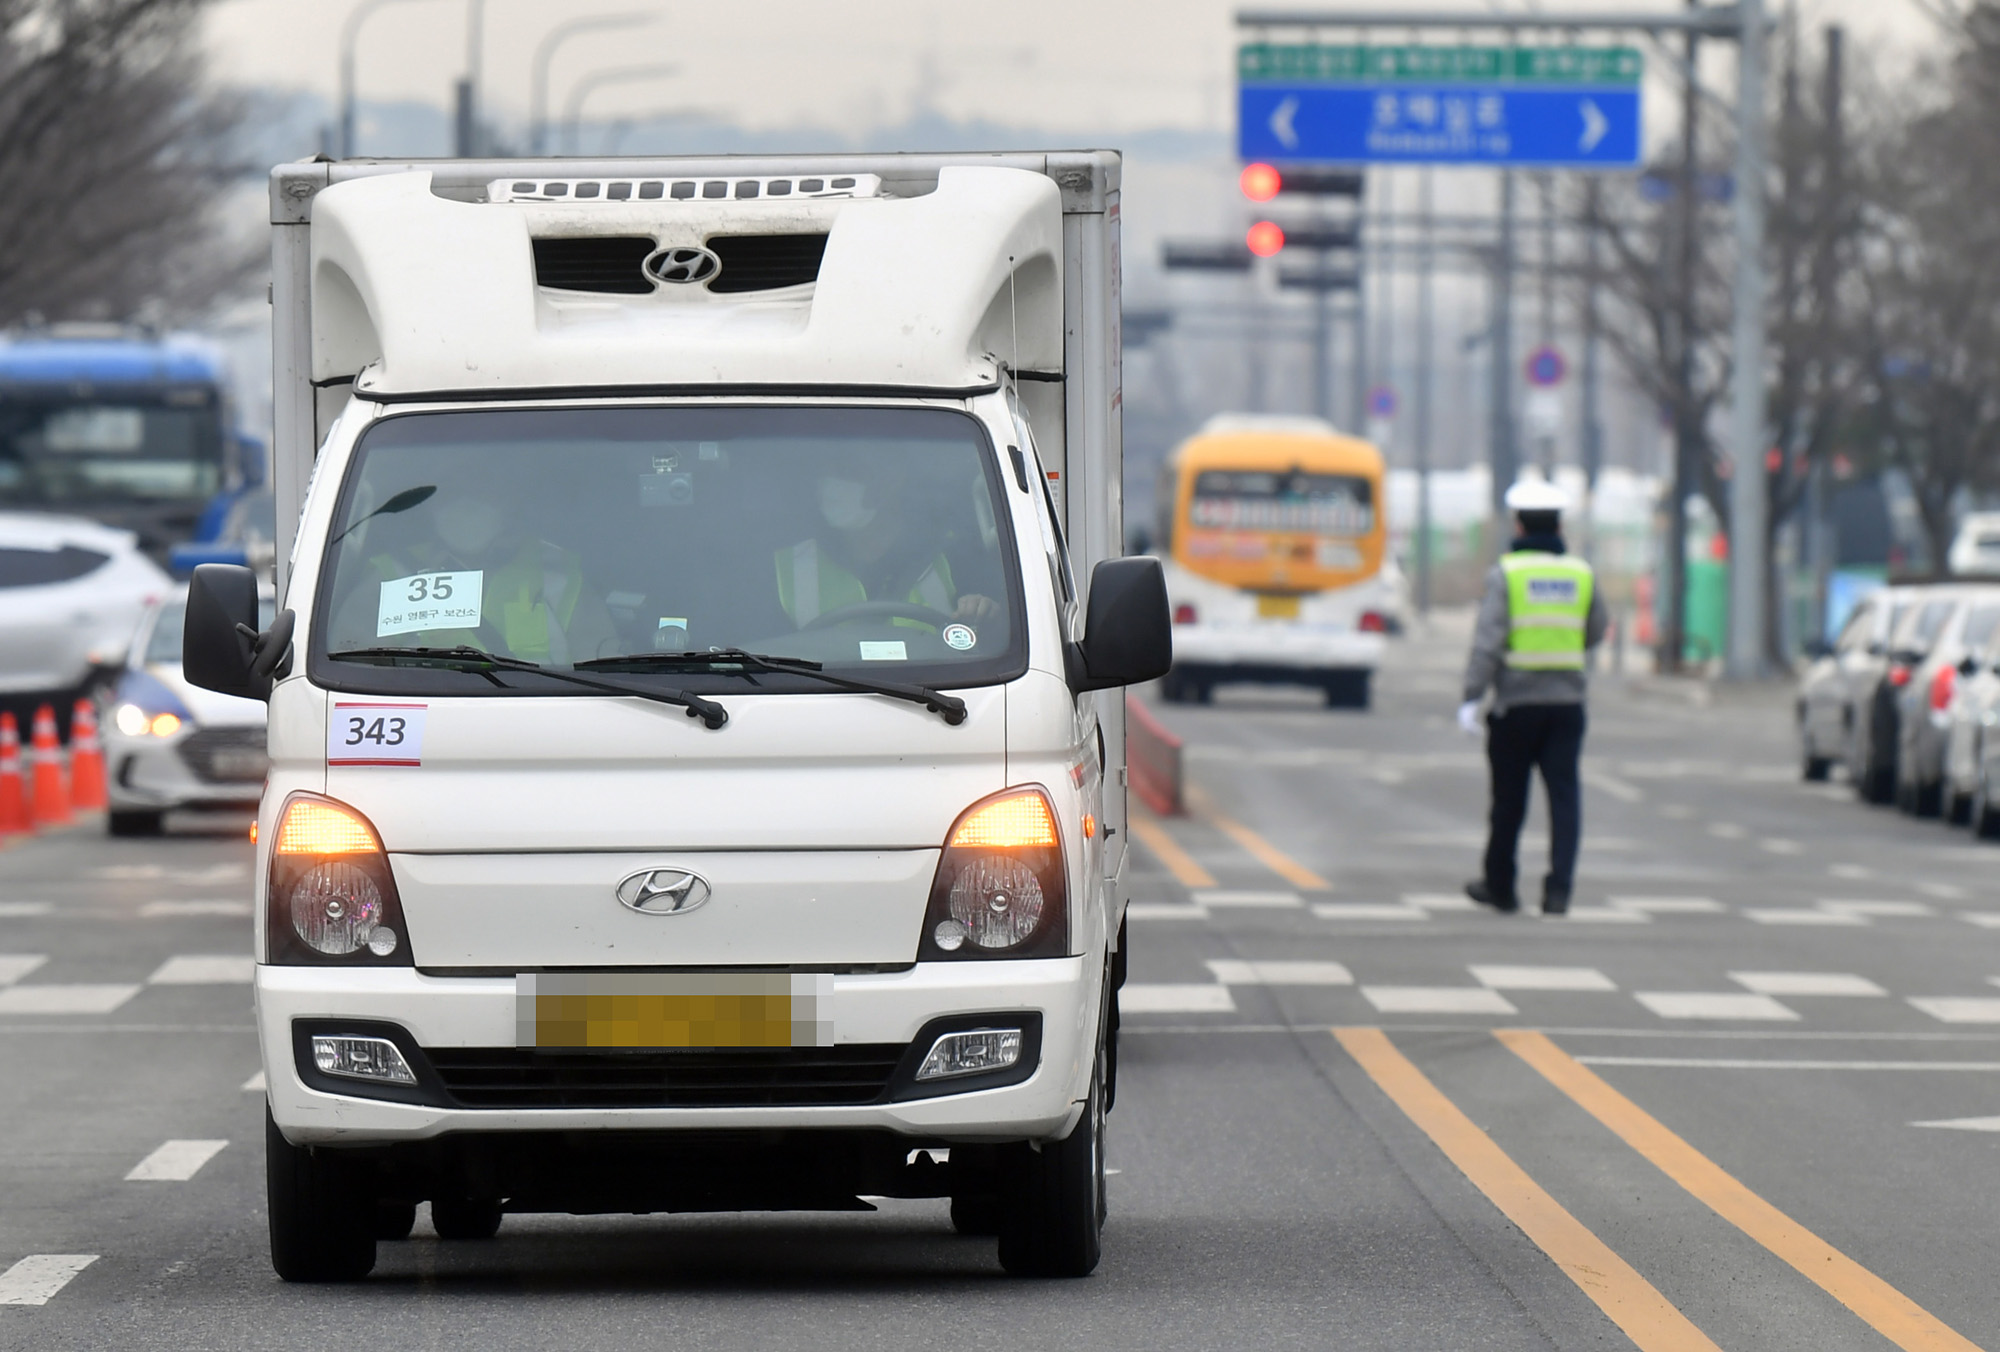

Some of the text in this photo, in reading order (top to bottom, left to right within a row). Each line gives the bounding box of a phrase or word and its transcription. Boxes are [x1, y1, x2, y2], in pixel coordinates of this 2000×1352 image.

[407, 576, 453, 602] 35
[382, 608, 477, 626] 수원 영통구 보건소
[345, 717, 406, 746] 343
